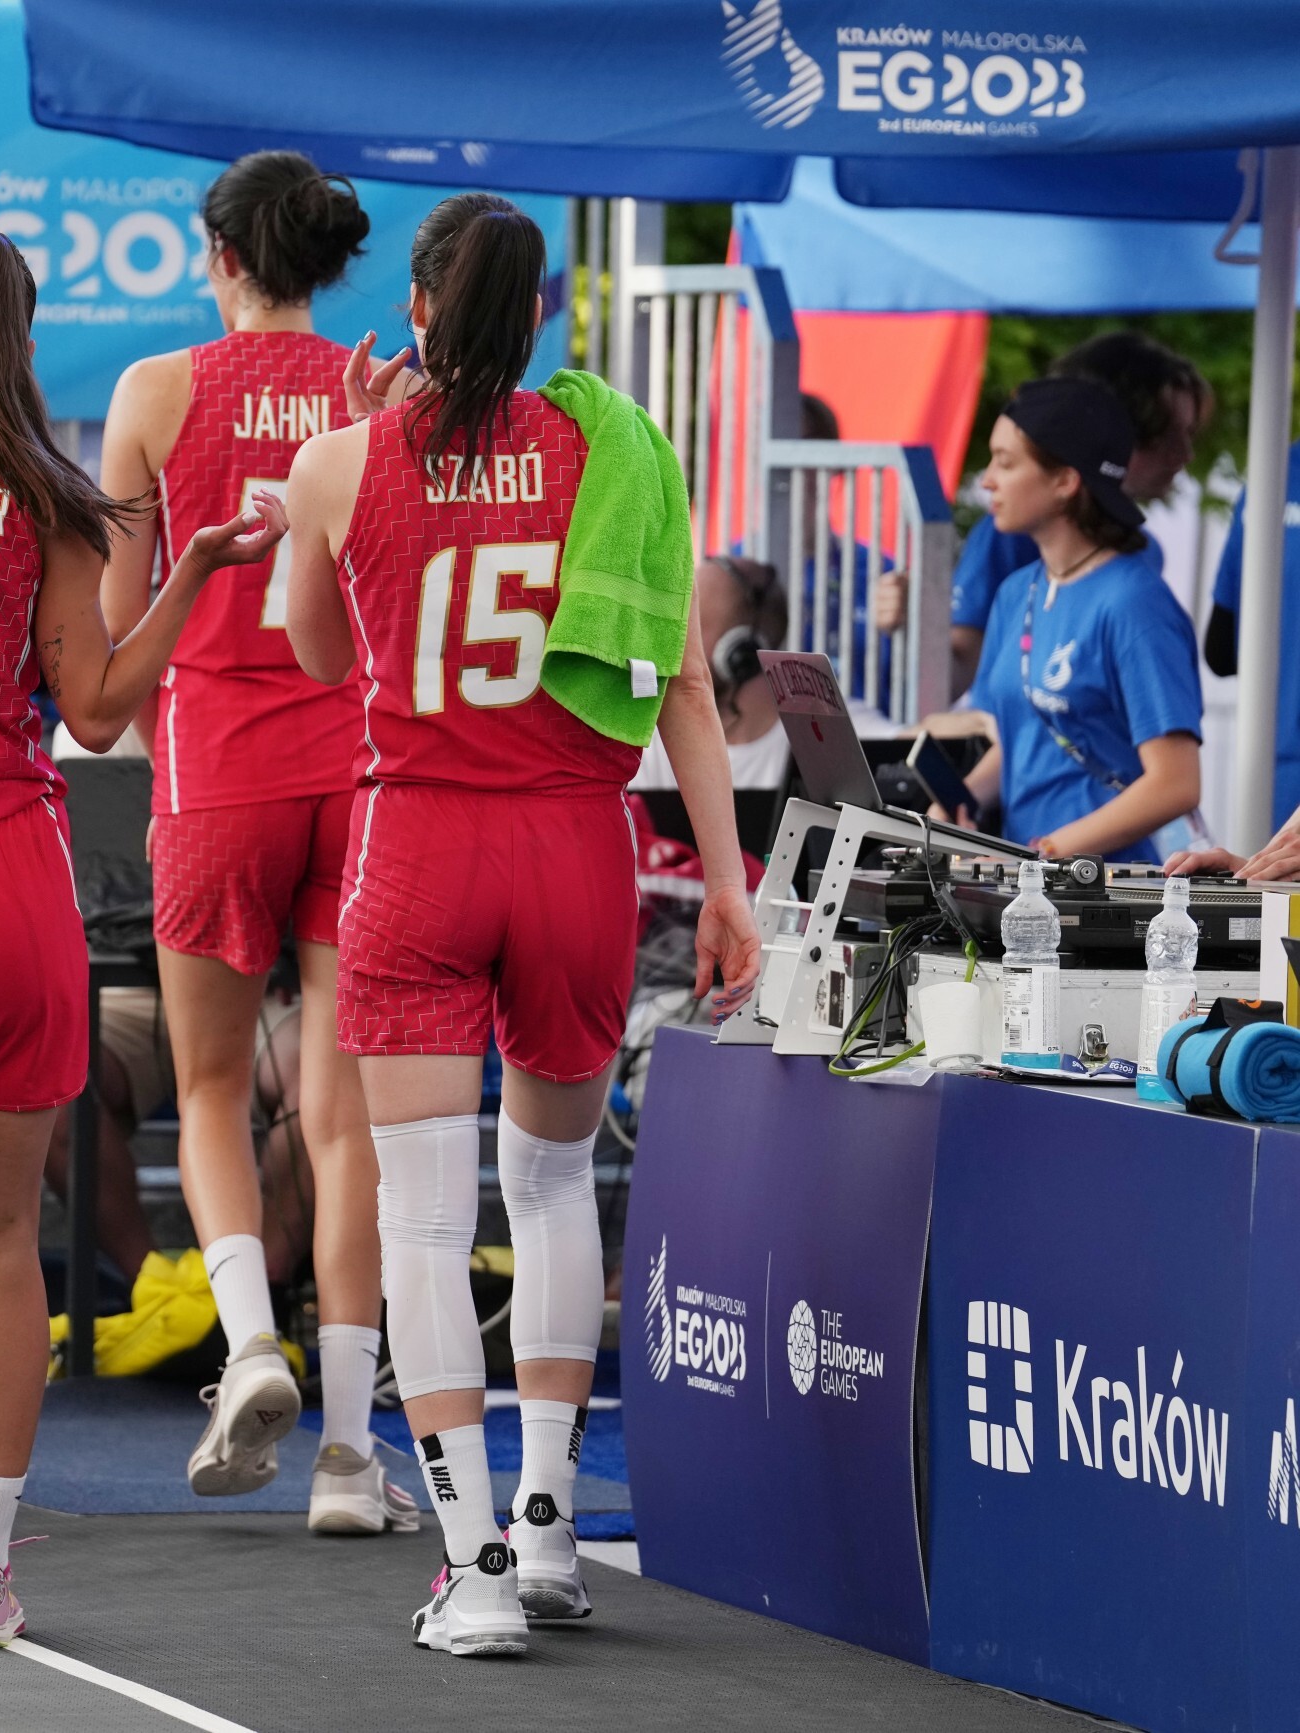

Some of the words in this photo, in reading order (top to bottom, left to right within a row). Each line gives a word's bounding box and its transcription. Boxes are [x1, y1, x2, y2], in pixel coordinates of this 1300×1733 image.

[837, 23, 933, 46] KRAKÓW
[941, 30, 1087, 53] MAŁOPOLSKA
[837, 50, 1086, 117] EG2023
[878, 118, 900, 133] 3rd
[902, 118, 986, 135] EUROPEAN
[987, 121, 1040, 137] GAMES
[234, 387, 330, 441] JÁHNI
[424, 442, 542, 504] SZABÓ
[413, 541, 560, 717] 15
[676, 1285, 704, 1306] KRAKÓW
[705, 1292, 747, 1317] MAŁOPOLSKA
[821, 1310, 843, 1339] THE
[675, 1308, 747, 1381] EG2023
[821, 1339, 884, 1379] EUROPEAN
[694, 1376, 719, 1393] EUROPEAN
[719, 1382, 736, 1398] GAMES
[821, 1369, 858, 1402] GAMES
[1056, 1339, 1229, 1507] Kraków
[429, 1466, 458, 1502] NIKE
